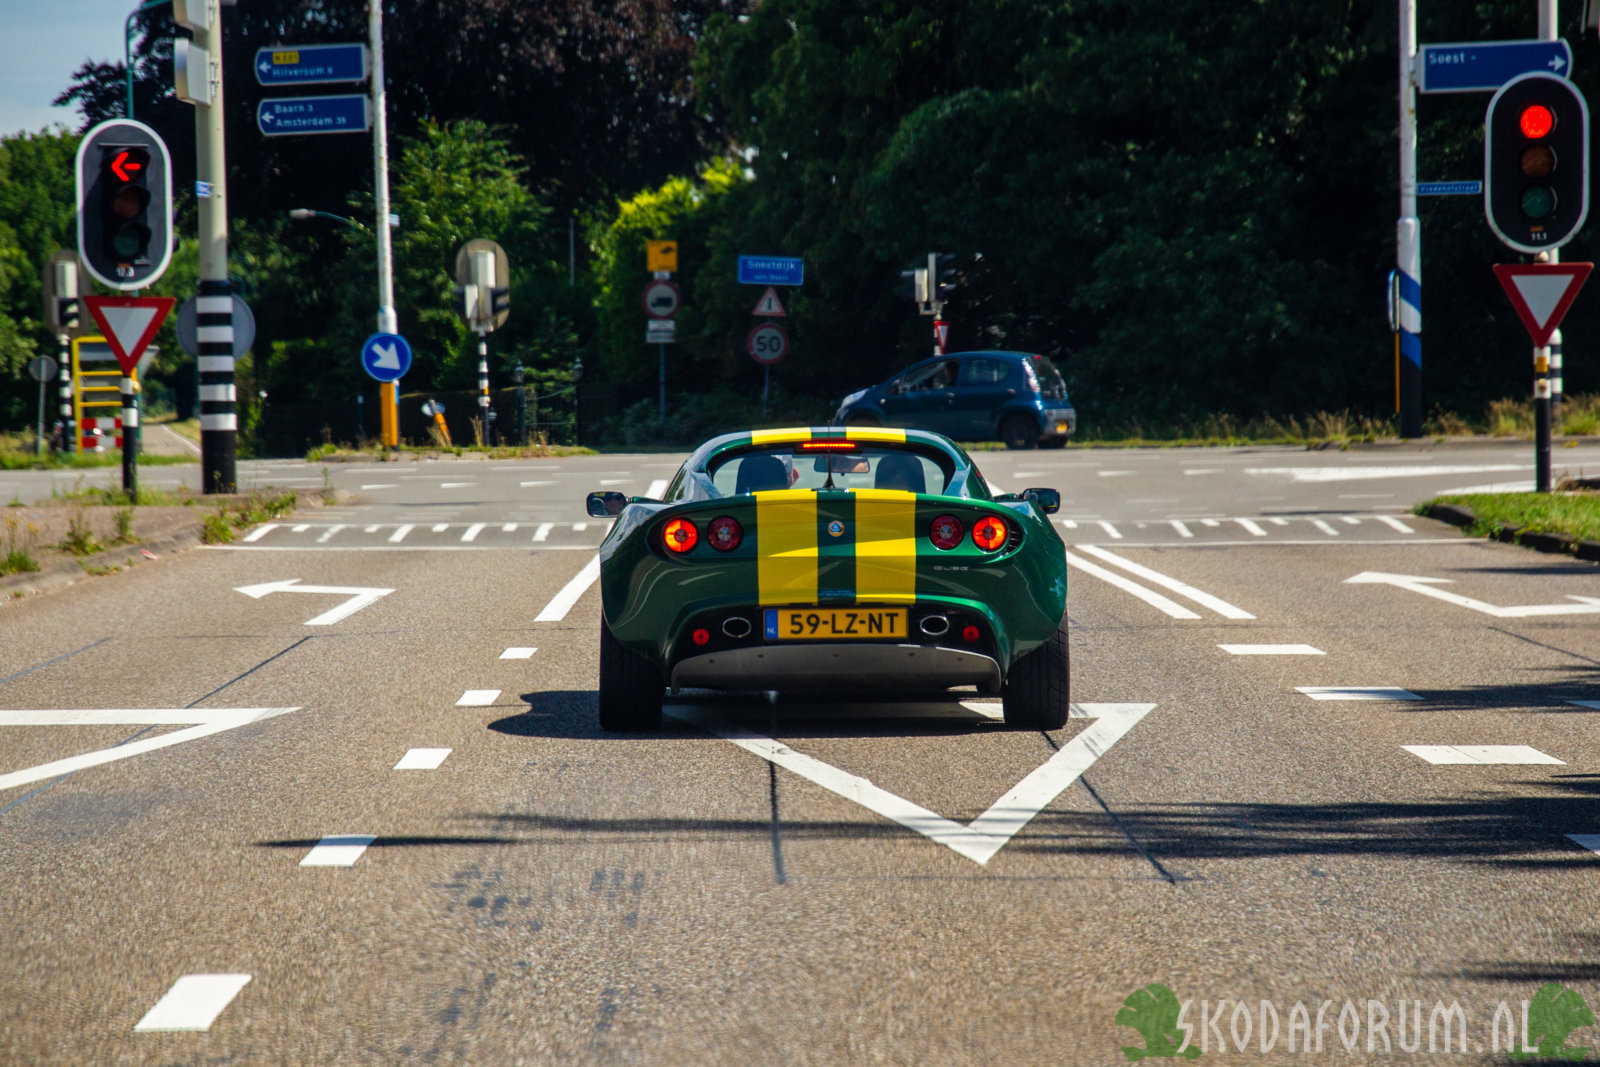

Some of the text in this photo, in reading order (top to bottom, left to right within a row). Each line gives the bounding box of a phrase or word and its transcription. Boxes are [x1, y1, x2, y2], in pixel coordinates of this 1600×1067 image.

[1429, 51, 1465, 65] Soest
[272, 66, 325, 76] Hilversum
[274, 104, 305, 113] Baarn
[275, 117, 333, 127] Amsterdam
[747, 260, 796, 272] Soestdijk
[756, 335, 781, 352] 50
[790, 613, 899, 635] 59-LZ-NT
